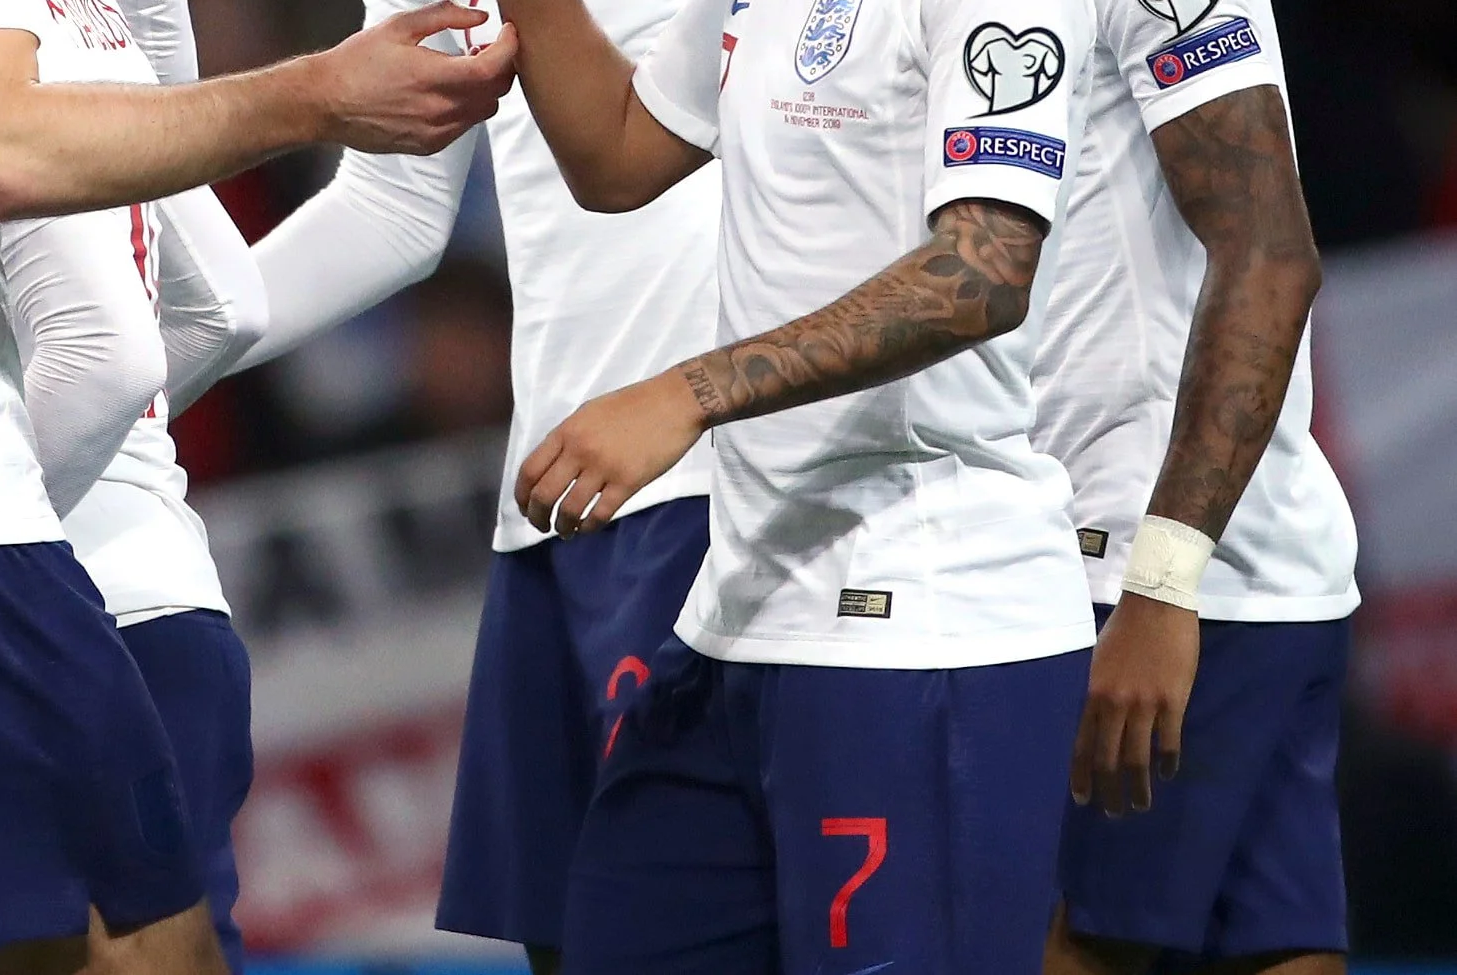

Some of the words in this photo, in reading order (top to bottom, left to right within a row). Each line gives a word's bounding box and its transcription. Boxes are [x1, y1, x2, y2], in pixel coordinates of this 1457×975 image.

[1182, 27, 1255, 70] RESPECT
[812, 105, 870, 120] INTERNATIONAL
[979, 137, 1064, 167] RESPECT
[821, 817, 887, 948] 7
